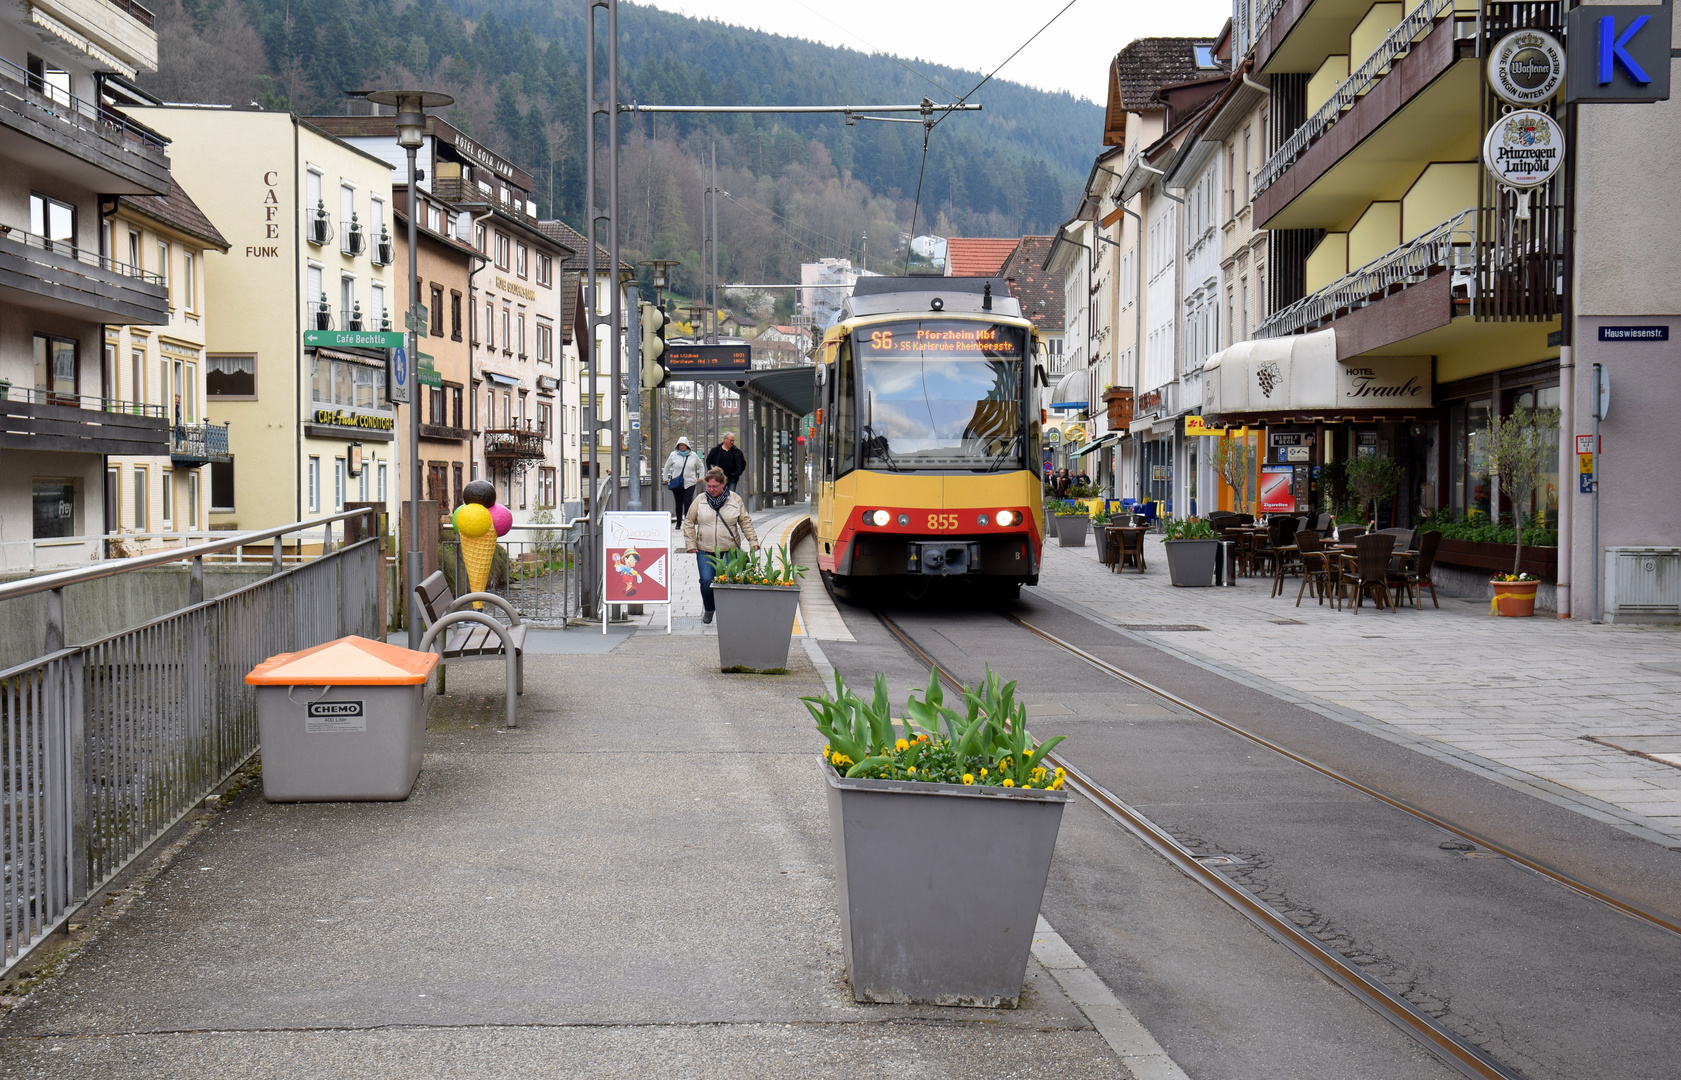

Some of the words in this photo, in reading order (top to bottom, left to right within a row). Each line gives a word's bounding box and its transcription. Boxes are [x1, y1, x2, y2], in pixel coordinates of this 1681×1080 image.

[1499, 48, 1513, 65] EINE
[1599, 15, 1652, 84] K
[1511, 57, 1550, 79] Warsteiner
[1547, 47, 1560, 75] BIEREN
[1499, 66, 1519, 95] KÖNIGIN
[1544, 75, 1558, 92] DEN
[1518, 89, 1544, 99] UNTER
[455, 134, 474, 154] HOTEL
[496, 160, 514, 178] LAMM
[1498, 147, 1557, 163] Prinzregent
[1503, 159, 1549, 176] Luitpold
[264, 170, 279, 239] CAFE
[246, 246, 279, 257] FUNK
[336, 334, 354, 344] Café
[355, 335, 386, 346] Bechtle
[871, 331, 893, 350] S6
[916, 330, 974, 341] Pforzheim
[976, 330, 996, 340] Hbf
[1604, 328, 1663, 338] Hauswiesenstr.
[900, 341, 911, 351] S5
[912, 341, 954, 351] Karlsruhe
[955, 341, 1015, 351] Rheinbergstr.
[1346, 368, 1375, 376] HOTEL
[396, 387, 406, 400] ZONE
[1346, 376, 1423, 398] Traube
[318, 410, 336, 424] CAFE
[337, 409, 358, 427] funk
[58, 500, 73, 518] Frey
[927, 514, 959, 530] 855
[314, 705, 357, 713] CHEMO
